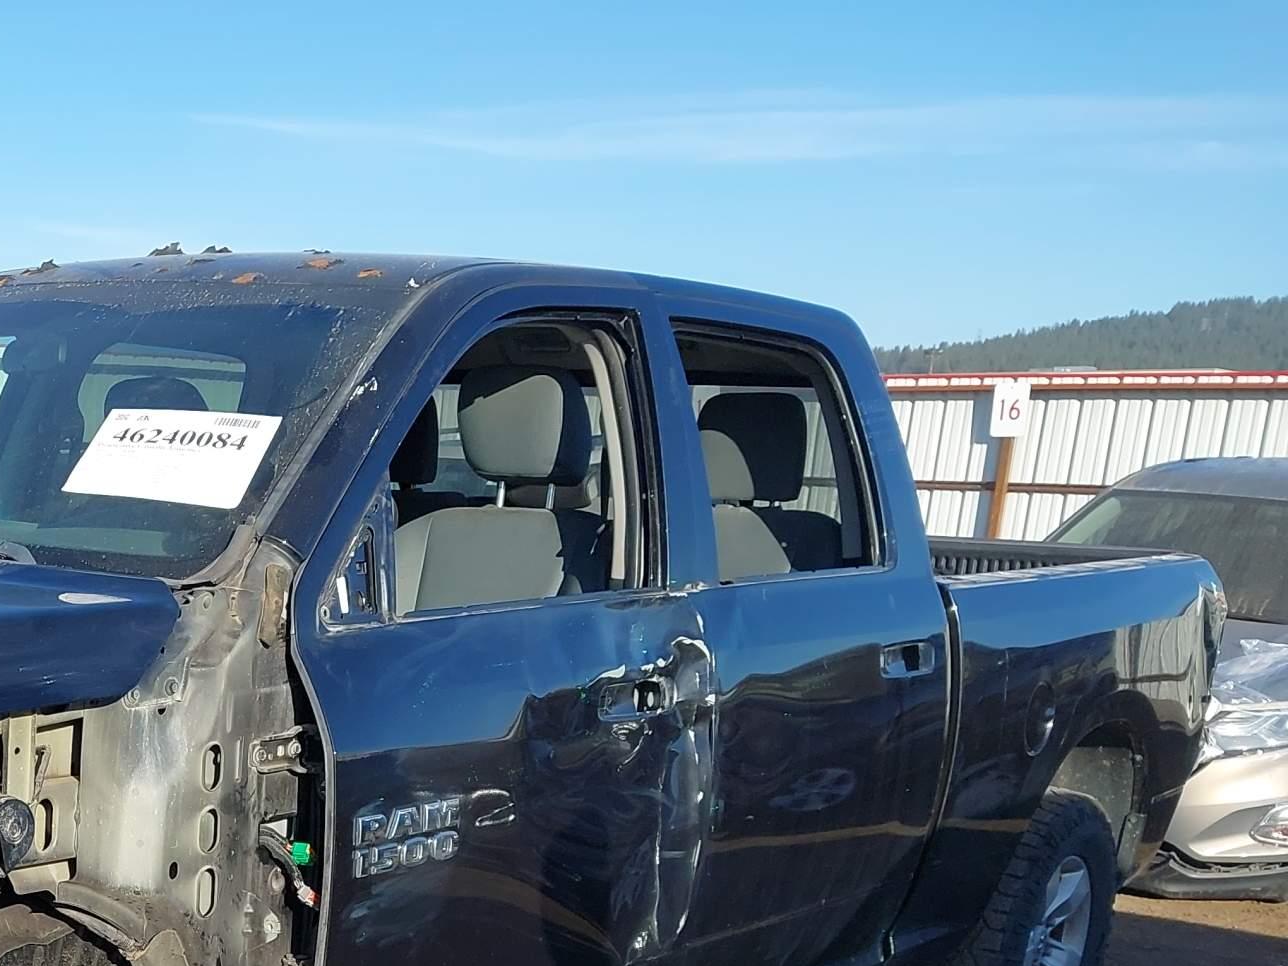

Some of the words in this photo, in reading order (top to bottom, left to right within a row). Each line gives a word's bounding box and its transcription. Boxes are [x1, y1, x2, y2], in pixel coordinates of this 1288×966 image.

[999, 398, 1021, 421] 16
[112, 427, 248, 451] 46240084
[352, 797, 461, 847] RAM
[352, 829, 461, 880] 1500
